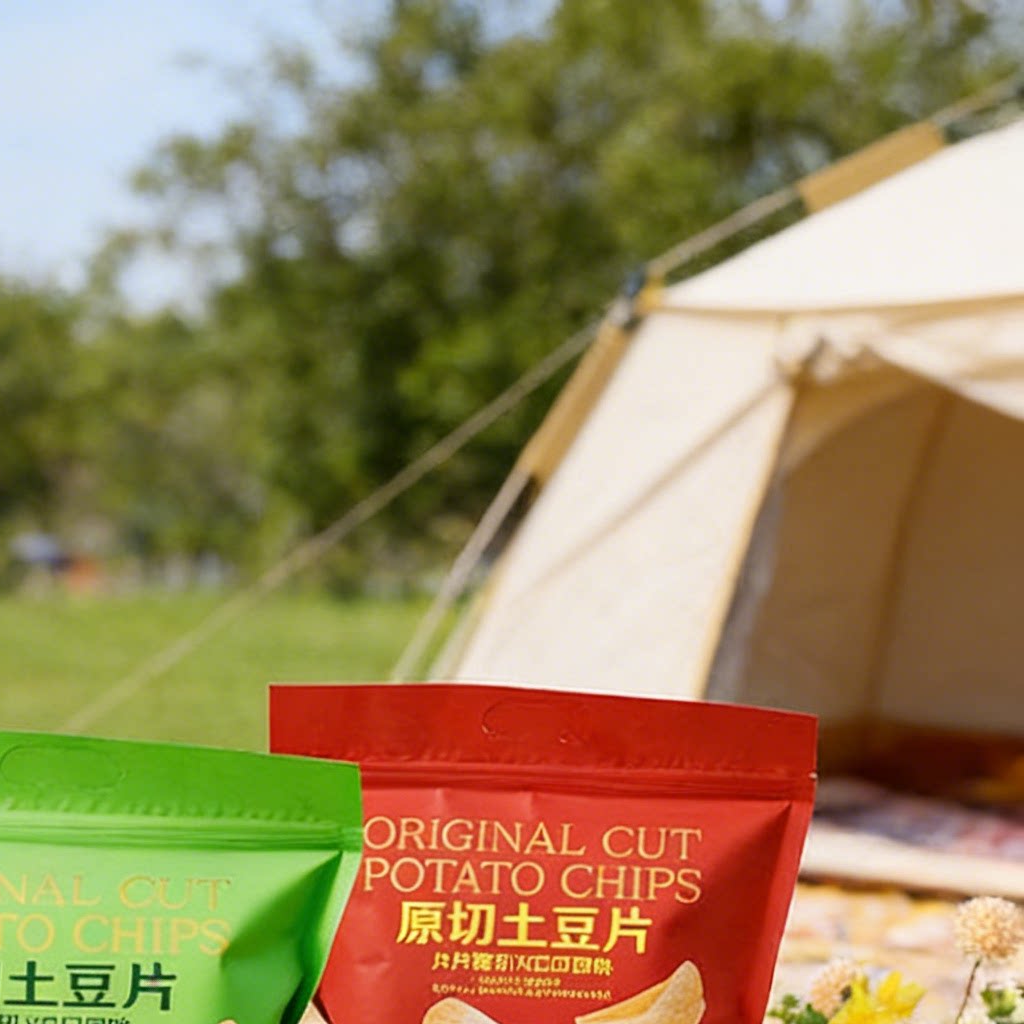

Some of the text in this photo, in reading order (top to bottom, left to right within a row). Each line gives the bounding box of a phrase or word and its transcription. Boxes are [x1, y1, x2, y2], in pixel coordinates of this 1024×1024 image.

[362, 816, 702, 861] ORIGINAL CUT
[118, 874, 232, 912] CUT
[363, 856, 702, 904] POTATO CHIPS
[73, 914, 232, 957] CHIPS
[396, 900, 653, 954] 原切土豆片
